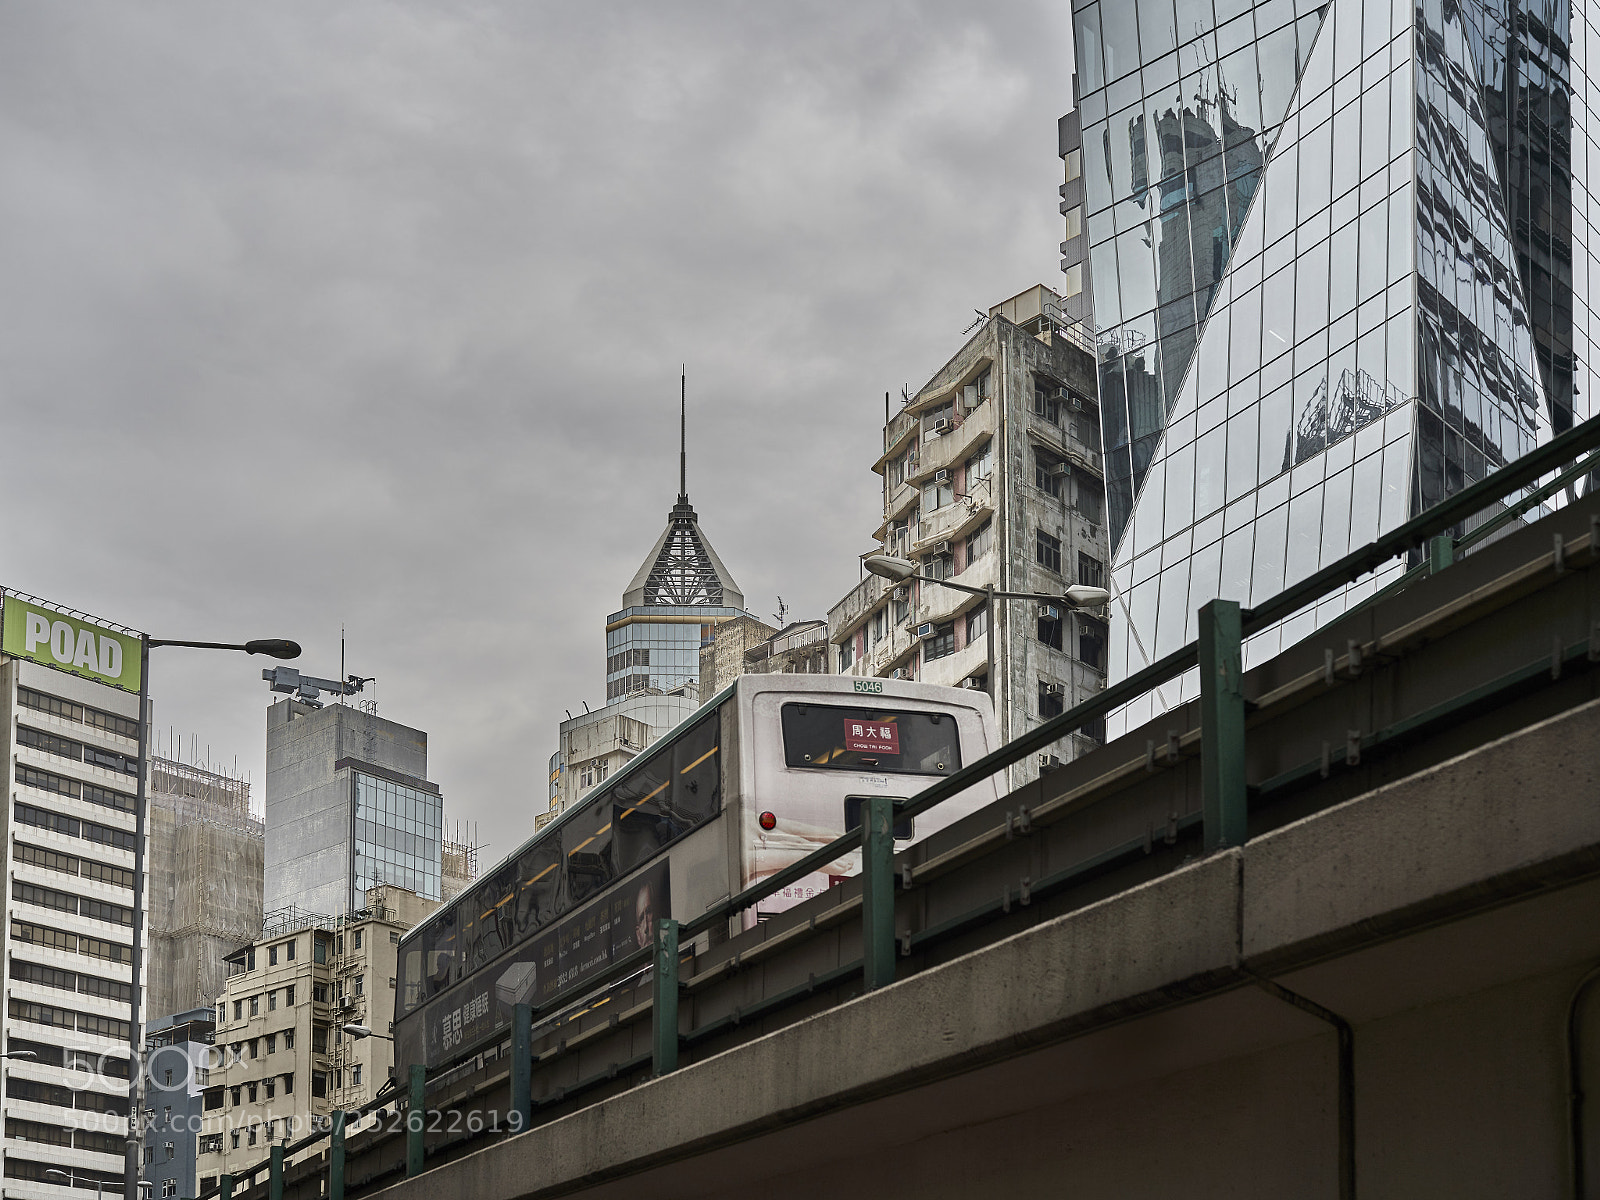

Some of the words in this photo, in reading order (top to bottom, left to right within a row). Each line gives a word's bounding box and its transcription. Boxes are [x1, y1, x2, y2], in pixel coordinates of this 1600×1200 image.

[25, 611, 123, 679] POAD
[855, 681, 882, 692] 5046
[852, 724, 892, 740] 周大福
[442, 1007, 463, 1051] 慕思
